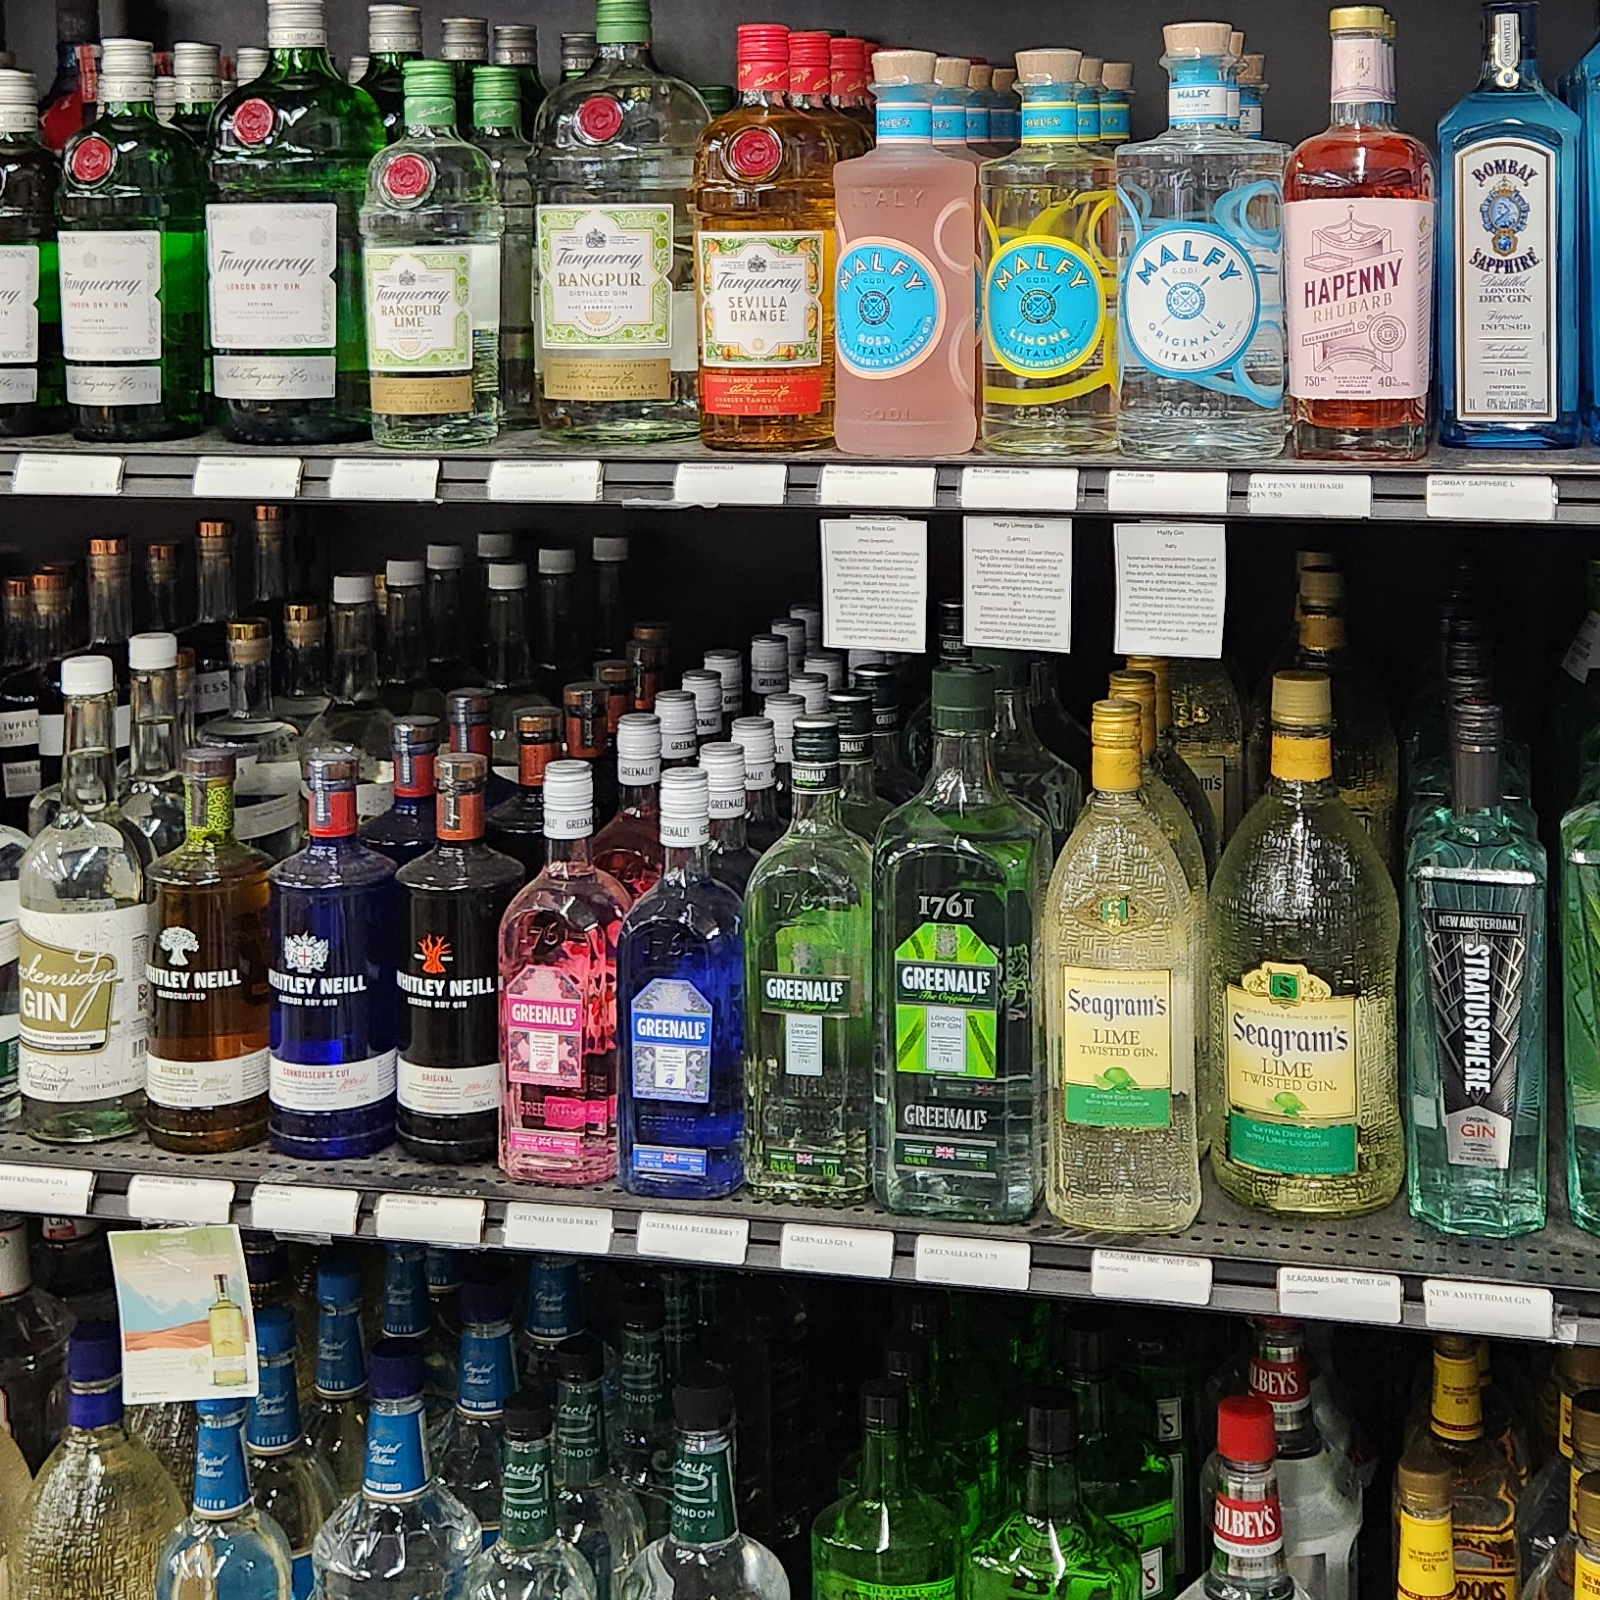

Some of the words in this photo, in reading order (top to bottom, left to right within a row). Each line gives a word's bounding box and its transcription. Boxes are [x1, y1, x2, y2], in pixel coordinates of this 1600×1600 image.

[1470, 158, 1540, 188] BOMBAY
[218, 250, 316, 276] Tanqueray
[557, 248, 643, 268] Tanqueray
[1136, 240, 1242, 285] MALFY
[1468, 247, 1541, 274] SAPPHIRE
[838, 252, 926, 292] MALFY
[994, 250, 1088, 292] MALFY
[64, 272, 142, 296] Tanqueray
[226, 283, 257, 291] LONDON
[260, 283, 280, 291] DRY
[284, 283, 301, 291] GIN
[716, 272, 803, 293] Tanqueray
[1479, 274, 1532, 287] Distilled
[376, 284, 450, 304] Tanqueray
[1478, 295, 1505, 303] DRY
[1507, 295, 1532, 303] GIN
[381, 304, 442, 316] RANGPUR
[728, 296, 788, 309] SEVILLA
[1314, 292, 1392, 324] RHUBARB
[394, 316, 424, 328] LIME
[1488, 310, 1523, 322] Vapour
[857, 333, 892, 346] ROSA
[1008, 327, 1071, 346] LIMONE
[1148, 320, 1227, 348] ORIGINALE
[1500, 368, 1516, 376] 1761
[918, 892, 975, 920] 1761
[1438, 914, 1459, 928] NEW
[194, 968, 242, 990] NEILL
[320, 974, 367, 995] NEILL
[450, 976, 496, 997] NEILL
[902, 966, 990, 995] GREENALL'S
[766, 978, 844, 1002] GREENALL'S
[918, 990, 939, 1002] The
[939, 992, 977, 1005] Original
[22, 987, 68, 1022] GIN
[278, 994, 302, 1006] LONDON
[304, 998, 320, 1007] DRY
[323, 998, 338, 1007] GIN
[407, 996, 432, 1008] LONDON
[434, 1000, 450, 1009] DRY
[452, 1000, 468, 1009] GIN
[795, 1000, 829, 1012] Original
[1068, 988, 1167, 1022] Seagram's
[512, 1002, 577, 1026] GREENALL'S
[930, 1014, 962, 1022] LONDON
[637, 1018, 706, 1040] GREENALL'S
[790, 1022, 818, 1030] LONDON
[790, 1028, 804, 1036] DRY
[930, 1022, 946, 1030] DRY
[946, 1022, 962, 1030] GIN
[1093, 1028, 1141, 1046] LIME
[1232, 1012, 1348, 1058] Seagram's
[1080, 1044, 1131, 1056] TWISTED
[282, 1067, 333, 1080] CONNOISSEUR'S
[335, 1068, 350, 1078] CUT
[1260, 1057, 1314, 1078] LIME
[422, 1073, 454, 1083] ORIGINAL
[1241, 1070, 1302, 1091] TWISTED
[904, 1104, 988, 1131] GREENALL'S
[1252, 1124, 1281, 1138] EXTRA
[1282, 1129, 1302, 1139] DRY
[1303, 1132, 1322, 1140] GIN
[1460, 1124, 1496, 1138] GIN
[513, 1213, 554, 1224] GREENALLS
[556, 1216, 575, 1224] WILD
[576, 1218, 599, 1226] BERRY
[646, 1220, 689, 1232] GREENALLS
[690, 1225, 732, 1237] BLUEBERRY
[790, 1234, 834, 1246] GREENALLS
[834, 1238, 848, 1246] GIN
[924, 1248, 968, 1258] GREENALLS
[970, 1251, 984, 1259] GIN
[1100, 1252, 1142, 1262] SEAGRAMS
[1143, 1255, 1160, 1263] LIME
[1162, 1258, 1185, 1266] TWIST
[1186, 1260, 1201, 1268] GIN
[1286, 1274, 1330, 1284] SEAGRAMS
[1331, 1276, 1350, 1284] LIME
[1351, 1278, 1375, 1286] TWIST
[1377, 1279, 1392, 1287] GIN
[1429, 1288, 1450, 1298] NEW
[1452, 1290, 1512, 1304] AMSTERDAM
[1513, 1296, 1532, 1306] GIN
[1429, 1299, 1436, 1308] L
[1456, 1397, 1469, 1405] GIN
[503, 1506, 548, 1520] LONDON
[1421, 1563, 1437, 1572] GIN
